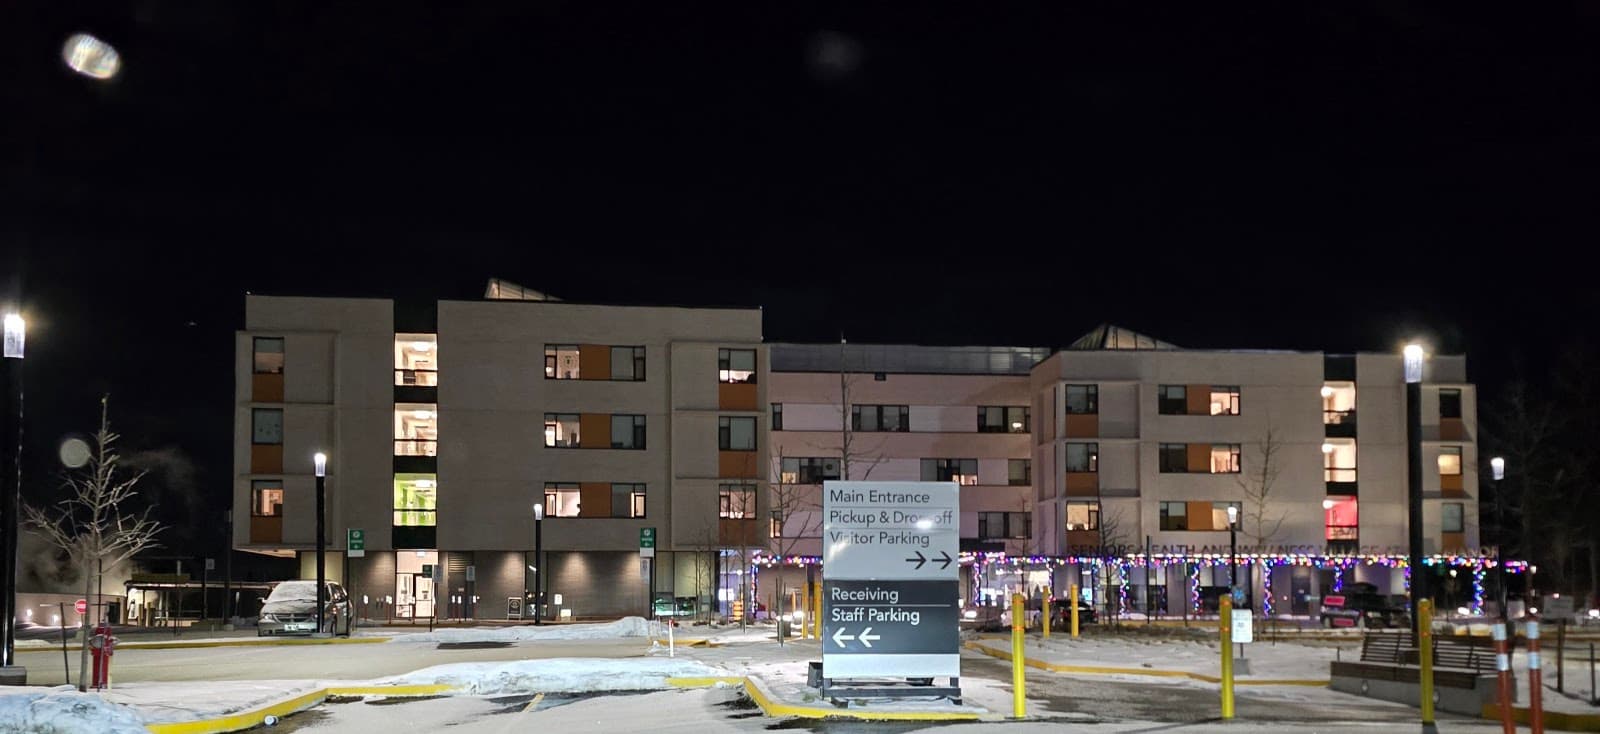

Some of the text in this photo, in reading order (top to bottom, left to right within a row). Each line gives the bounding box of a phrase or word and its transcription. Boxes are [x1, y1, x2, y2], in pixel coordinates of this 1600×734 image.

[830, 489, 930, 504] Main Entrance
[830, 510, 953, 528] Pickup & Drooff
[879, 531, 930, 548] Parking
[831, 587, 899, 604] Receiving
[831, 607, 920, 625] Staff Parking
